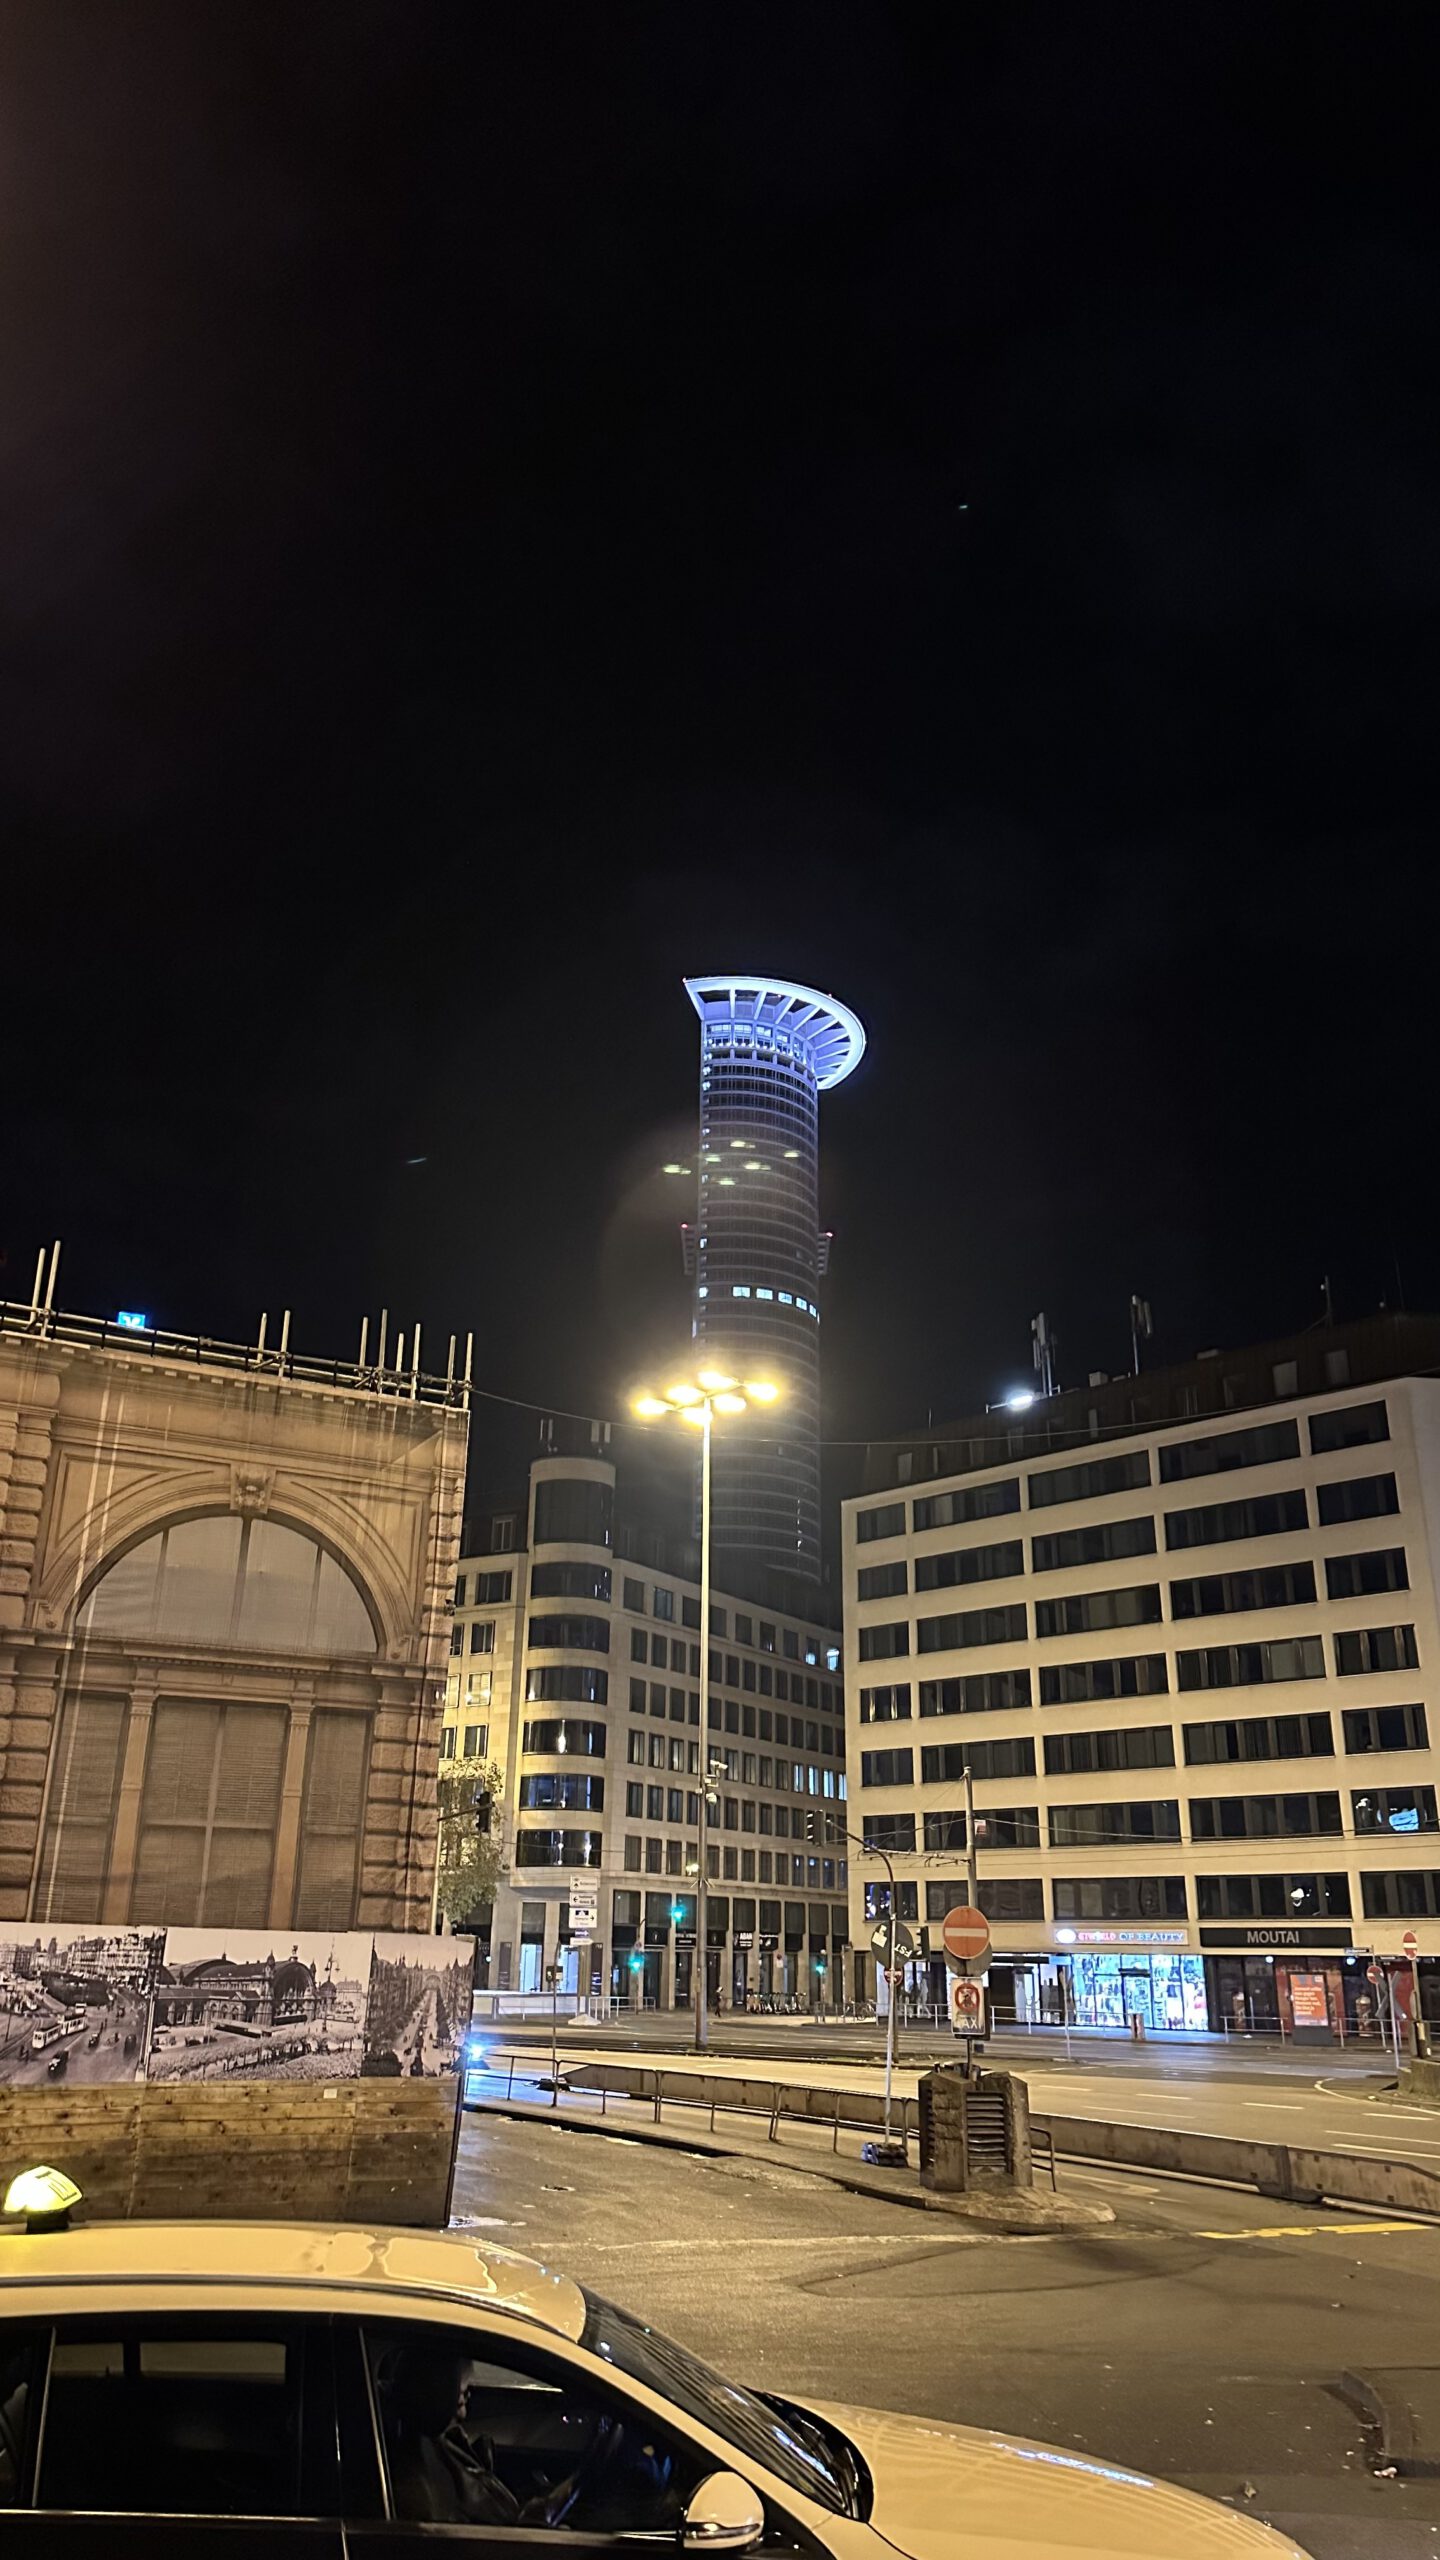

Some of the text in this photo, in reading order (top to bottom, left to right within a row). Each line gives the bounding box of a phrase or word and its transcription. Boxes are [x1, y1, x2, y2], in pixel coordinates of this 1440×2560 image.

[1119, 1932, 1135, 1941] OF
[1137, 1932, 1184, 1941] BEAUTY
[1247, 1931, 1300, 1944] MOUTAI
